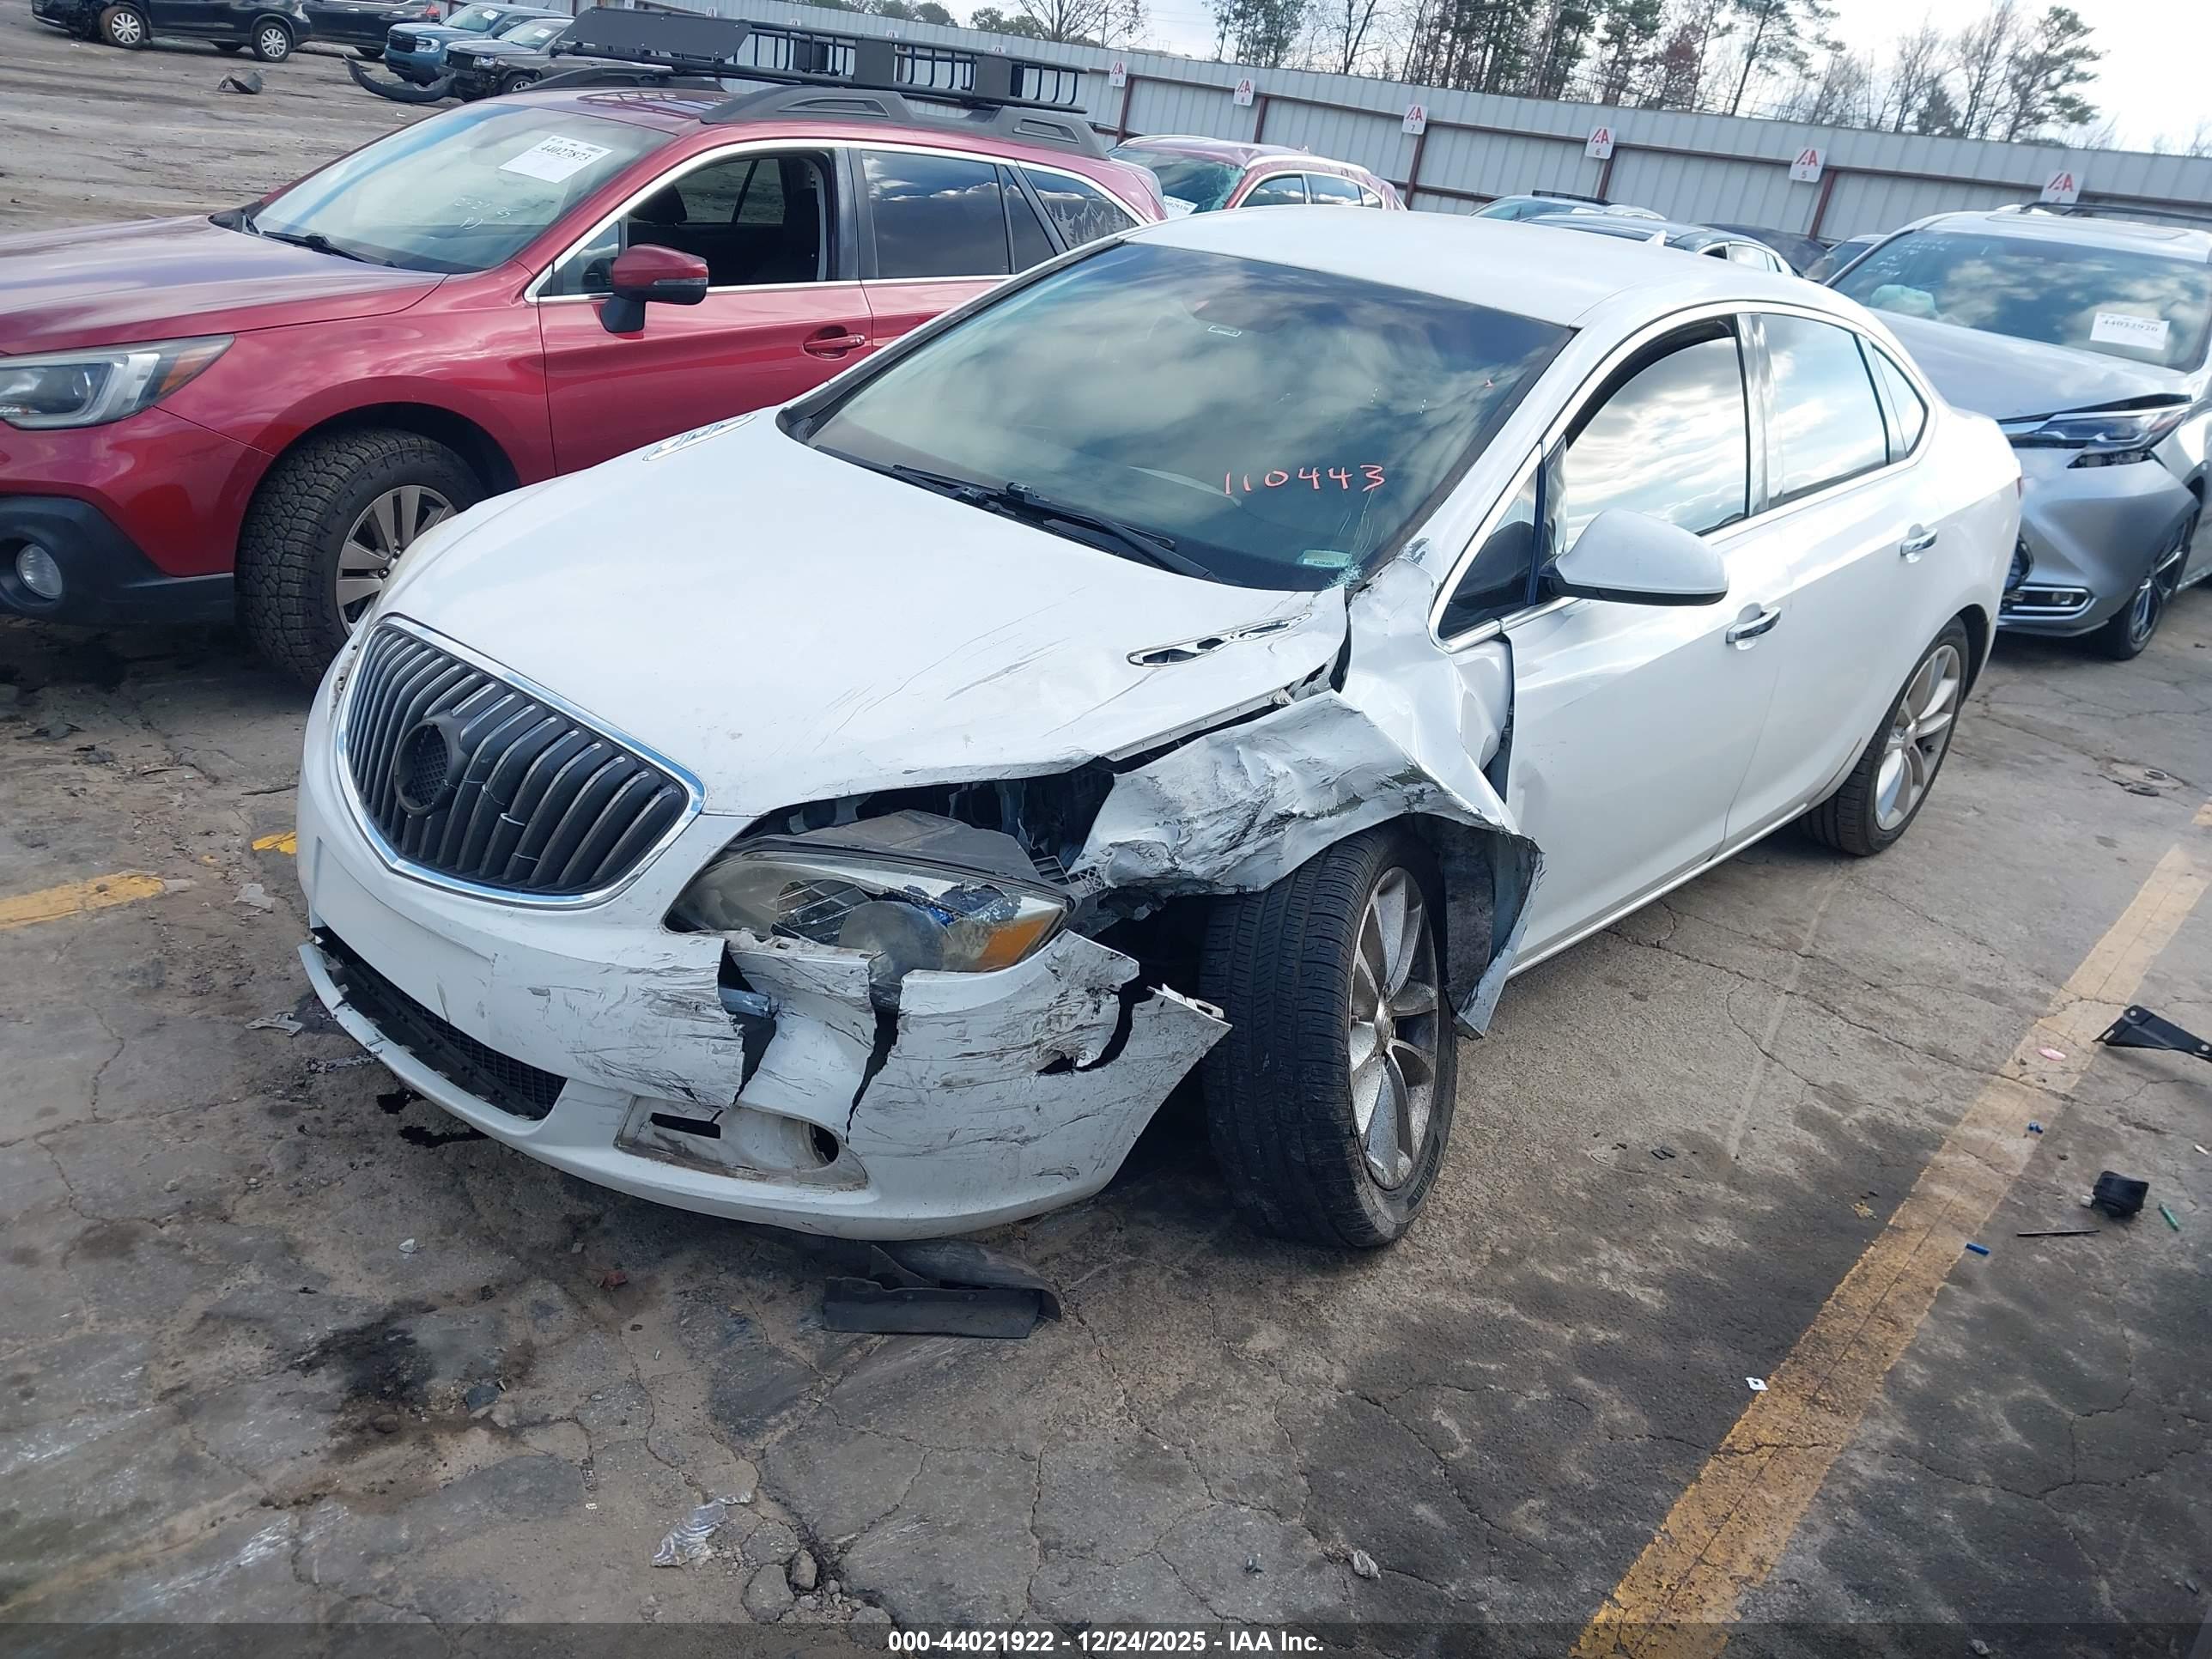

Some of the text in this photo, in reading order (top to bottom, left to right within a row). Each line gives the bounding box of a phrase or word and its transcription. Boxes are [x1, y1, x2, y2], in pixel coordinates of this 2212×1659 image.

[1595, 148, 1601, 156] 6
[1801, 170, 1808, 179] 5
[1224, 463, 1387, 496] 110443
